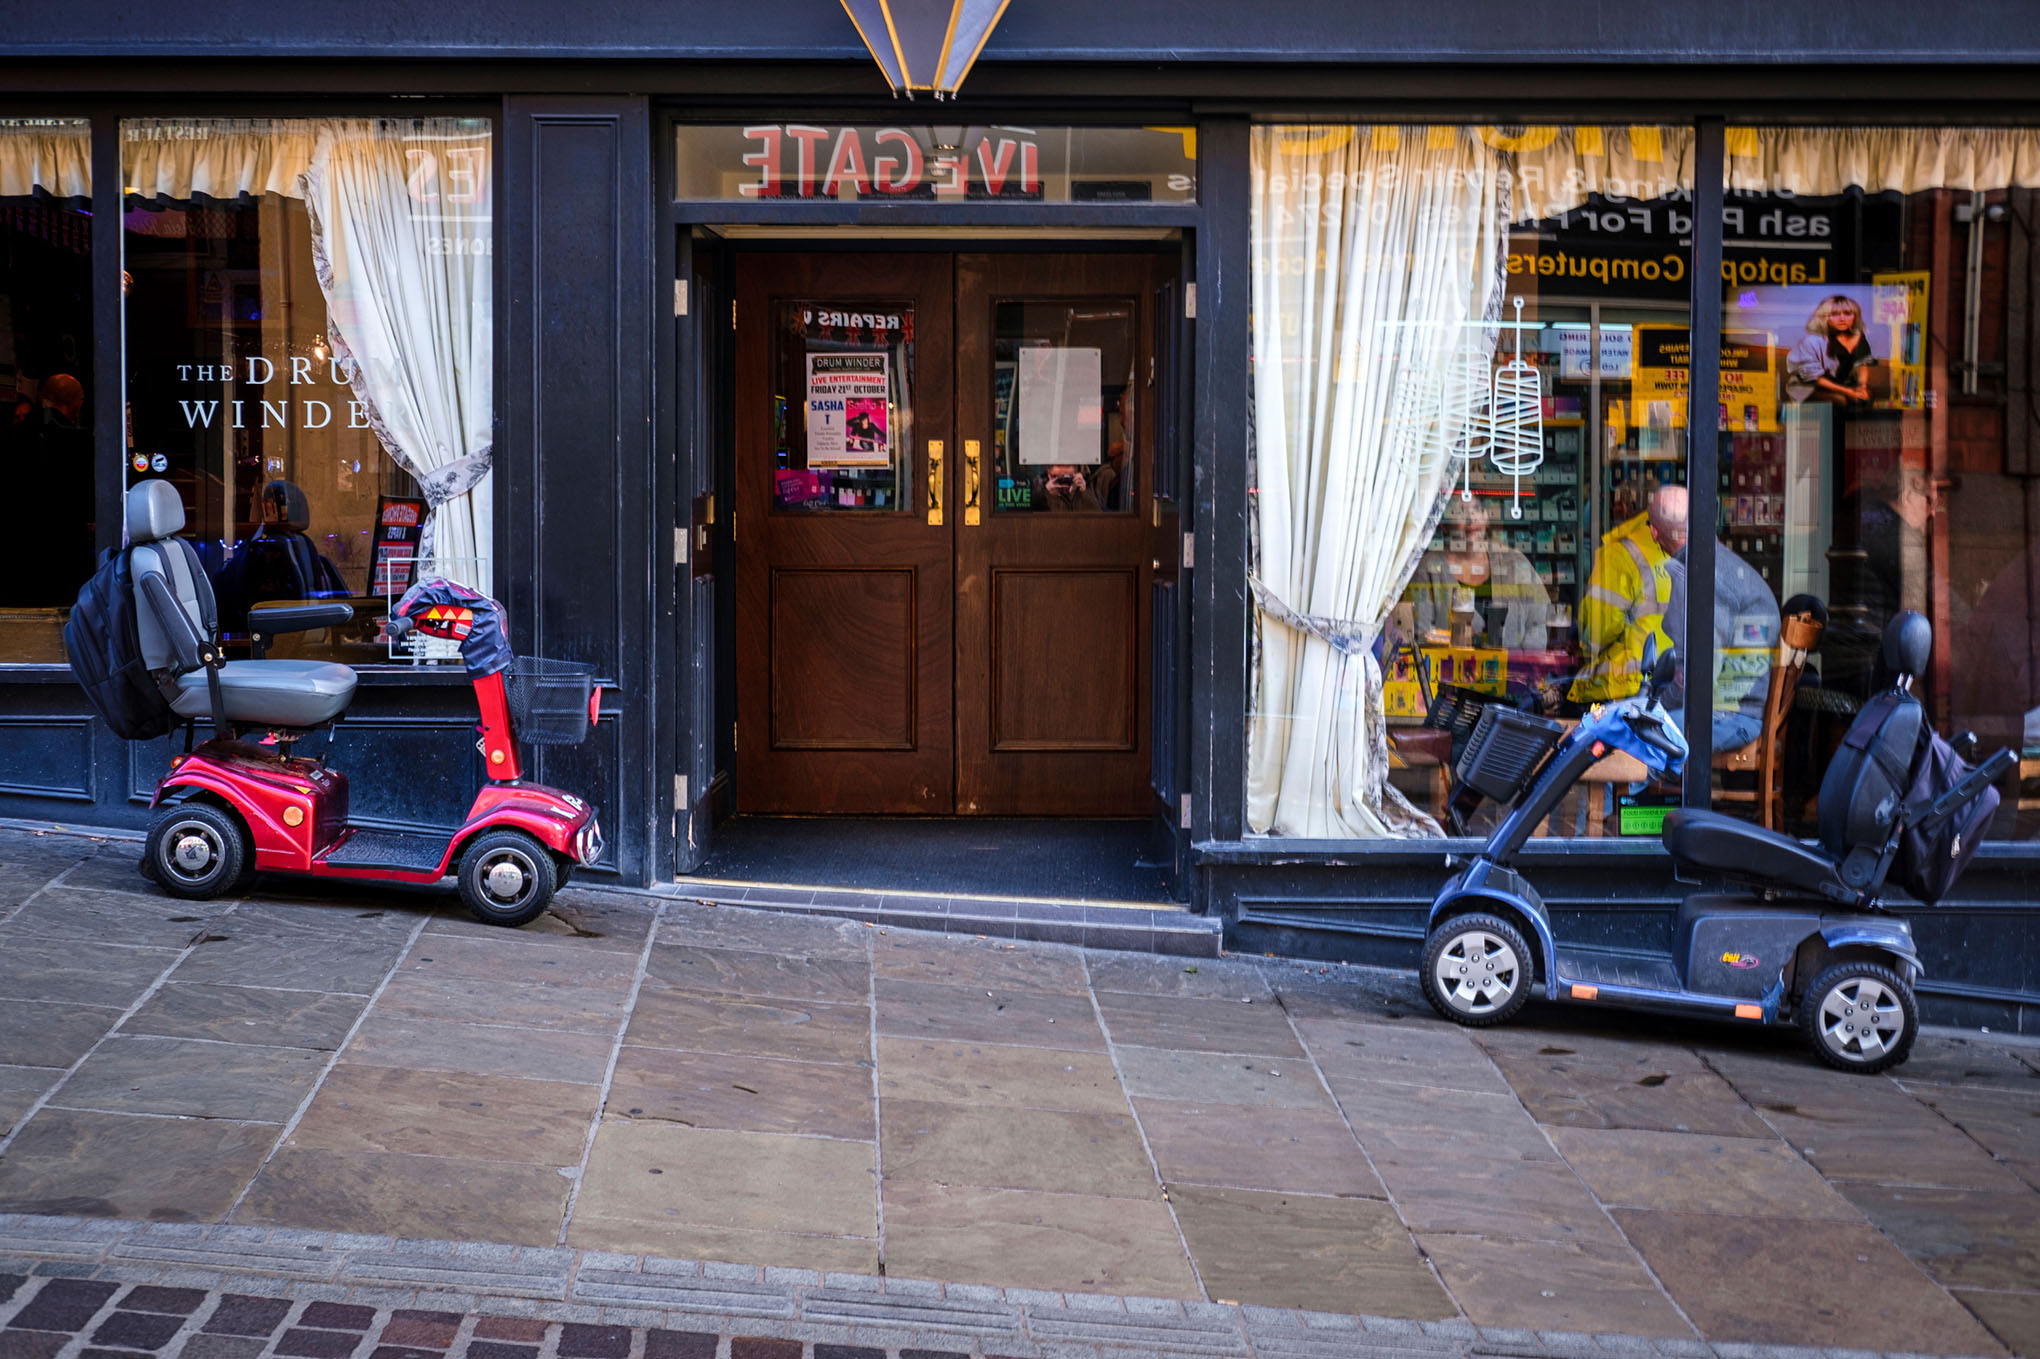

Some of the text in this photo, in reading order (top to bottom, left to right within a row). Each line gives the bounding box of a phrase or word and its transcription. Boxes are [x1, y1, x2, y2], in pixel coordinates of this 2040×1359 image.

[816, 357, 881, 368] DRUM WINDER
[176, 364, 233, 382] THE
[811, 374, 886, 386] LIVE ENTERTAINMENT
[810, 384, 837, 394] FRIDAY
[853, 384, 886, 394] OCTOBER
[810, 400, 845, 412] SASHA
[824, 414, 831, 425] T
[998, 487, 1032, 503] LIVE
